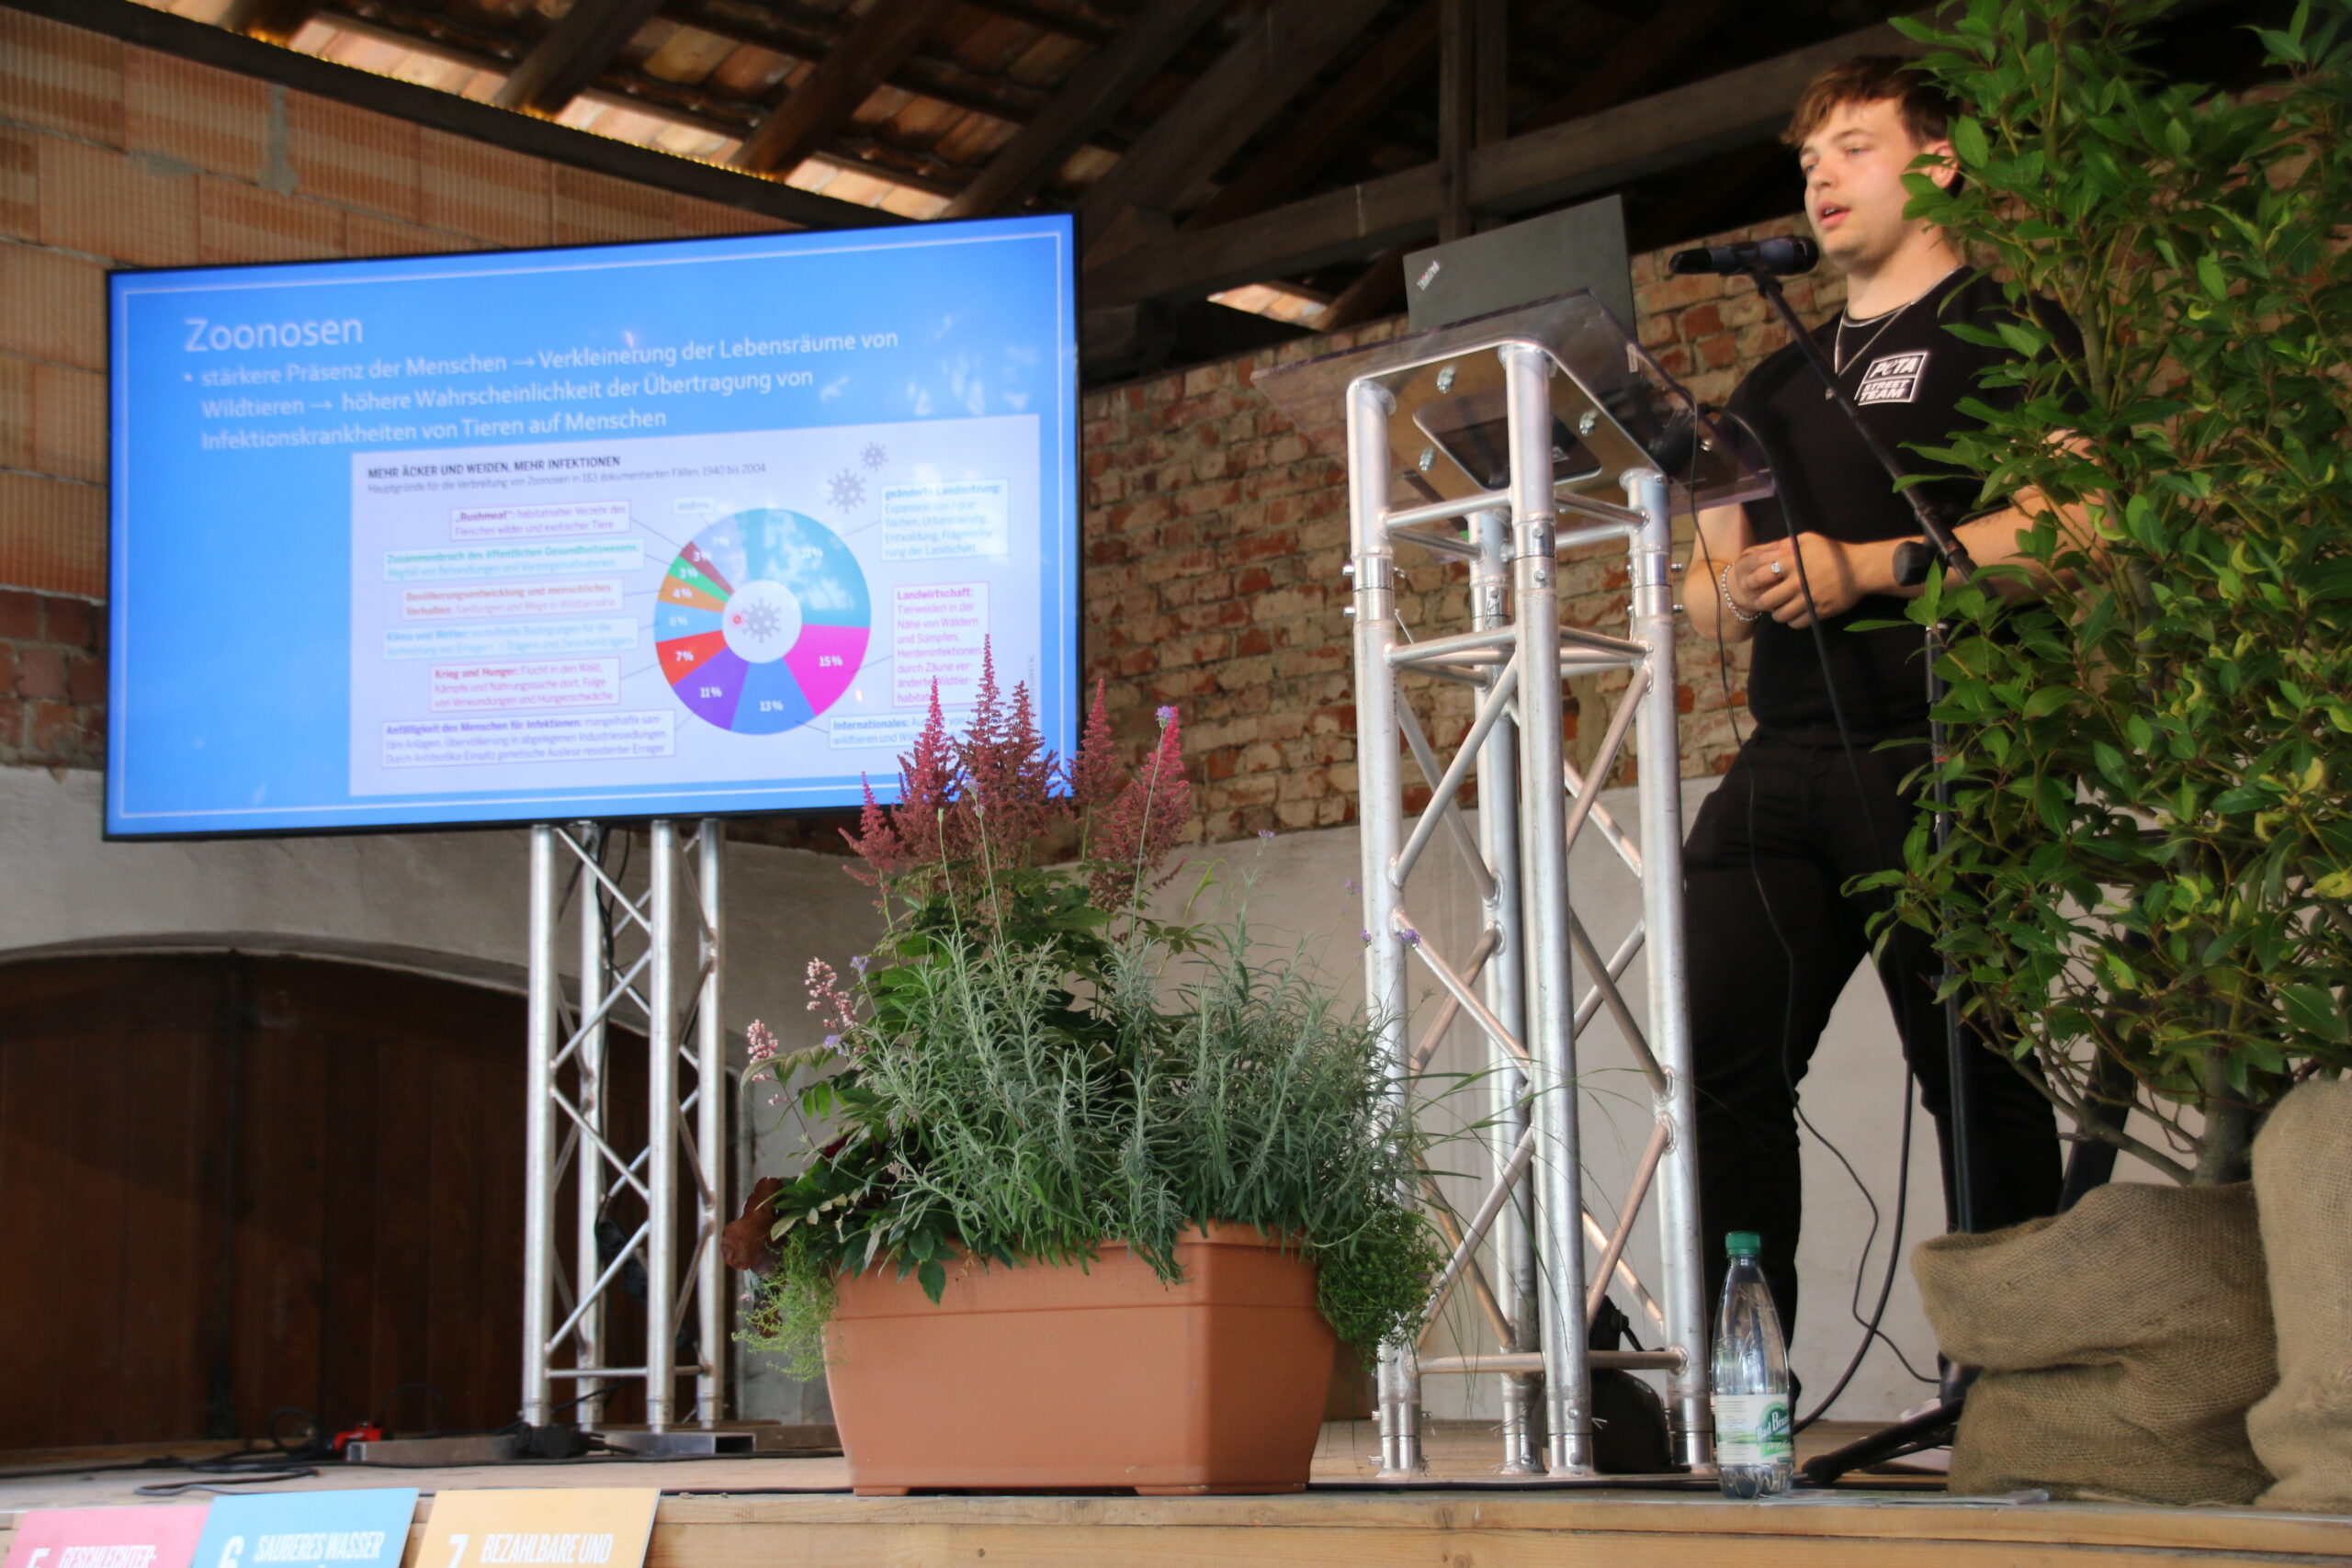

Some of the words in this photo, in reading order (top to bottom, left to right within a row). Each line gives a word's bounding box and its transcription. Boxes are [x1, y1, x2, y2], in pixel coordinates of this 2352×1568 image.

[184, 316, 363, 352] Zoonosen
[200, 366, 282, 388] stärkere
[286, 361, 364, 384] Präsenz
[368, 359, 401, 380] der
[406, 355, 507, 378] Menschen
[537, 343, 676, 371] Verkleinerung
[682, 340, 714, 362] der
[718, 333, 855, 360] Lebensräume
[861, 332, 899, 350] von
[200, 397, 304, 420] Wildtieren
[341, 389, 411, 412] höhere
[415, 382, 602, 409] Wahrscheinlichkeit
[607, 378, 639, 398] der
[643, 371, 771, 397] Übertragung
[776, 370, 813, 388] von
[1860, 389, 1905, 401] TEAM
[1863, 379, 1911, 392] STREET
[201, 422, 416, 452] Infektionskrankheiten
[422, 423, 458, 440] von
[461, 415, 525, 438] Tieren
[528, 413, 561, 434] auf
[565, 411, 666, 433] Menschen
[368, 465, 398, 479] MEHR
[402, 463, 437, 478] ÄCKER
[441, 461, 464, 476] UND
[466, 458, 511, 474] WEIDEN,
[514, 457, 544, 471] MEHR
[548, 453, 620, 469] INFEKTIONEN
[368, 481, 425, 495] Hauptgründe
[426, 480, 437, 491] für
[441, 479, 456, 490] die
[457, 477, 507, 491] Verbreitung
[509, 478, 525, 486] von
[527, 473, 569, 485] Zoonosen
[571, 473, 579, 482] in
[582, 472, 597, 482] 183
[599, 468, 670, 481] dokumentierten
[703, 465, 725, 476] 1940
[727, 464, 740, 474] bis
[741, 462, 766, 473] 2004
[897, 587, 973, 600] Landwirtschaft:
[833, 717, 909, 730] Internationales:
[1757, 1423, 1771, 1441] Bad
[254, 1532, 328, 1562] SAUBERES
[324, 1530, 386, 1560] WASSER
[480, 1533, 581, 1563] BEZAHLBARE
[578, 1533, 614, 1563] UND
